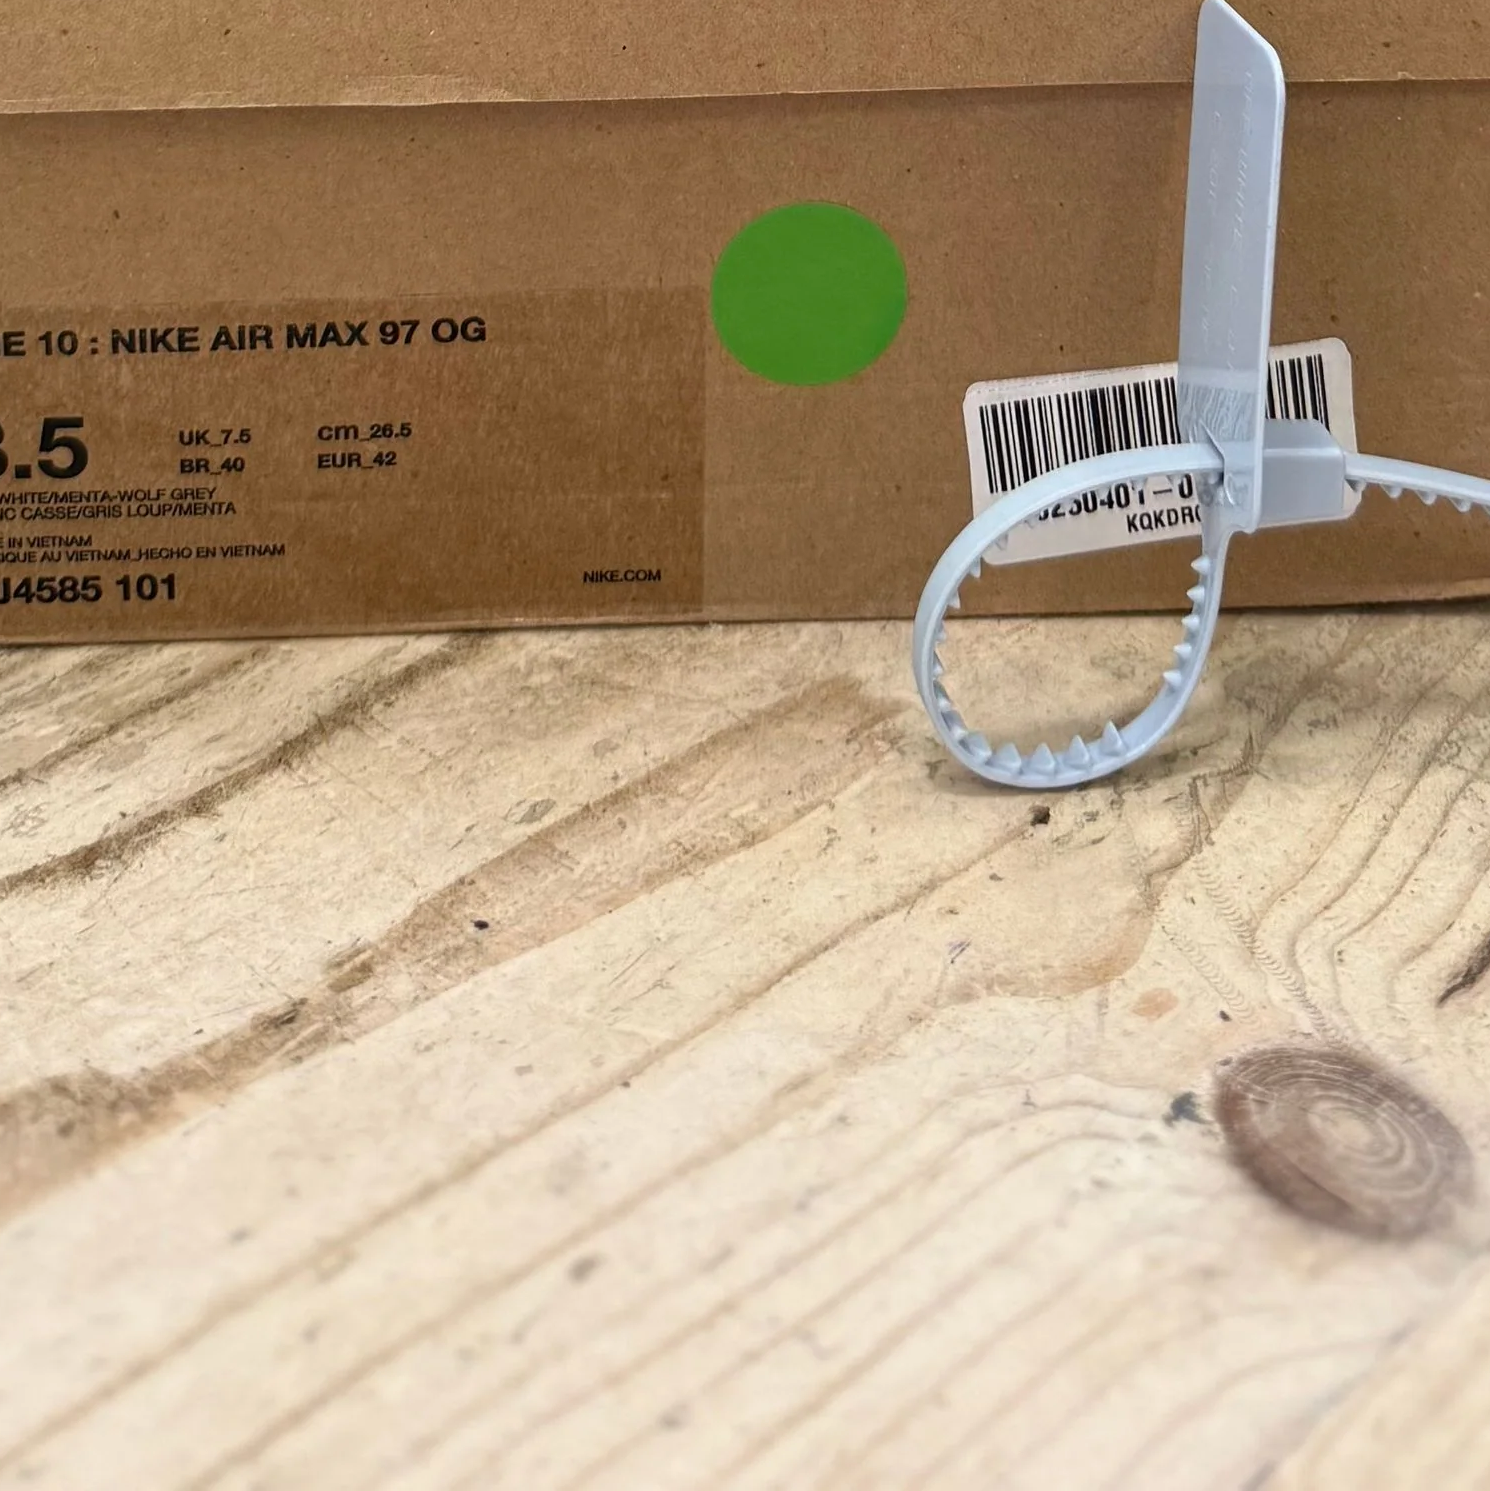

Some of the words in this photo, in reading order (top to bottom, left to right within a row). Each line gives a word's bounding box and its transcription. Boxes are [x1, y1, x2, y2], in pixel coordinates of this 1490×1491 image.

[38, 330, 78, 356] 10
[111, 326, 200, 355] NIKE
[210, 325, 274, 351] AIR
[286, 320, 369, 349] MAX
[379, 320, 420, 345] 97
[431, 316, 487, 343] OG
[178, 427, 252, 447] UK_7.5
[179, 456, 245, 476] BR_40
[317, 450, 398, 470] EUR_42
[170, 487, 217, 501] GREY
[21, 504, 122, 520] CASSE/GRIS
[127, 501, 237, 517] LOUP/MENTA
[9, 536, 23, 548] IN
[26, 534, 93, 548] VIETNAM
[40, 550, 61, 563] AU
[196, 545, 217, 559] EN
[220, 543, 286, 557] VIETNAM
[582, 568, 662, 583] NIKE.COM
[116, 573, 176, 602] 101
